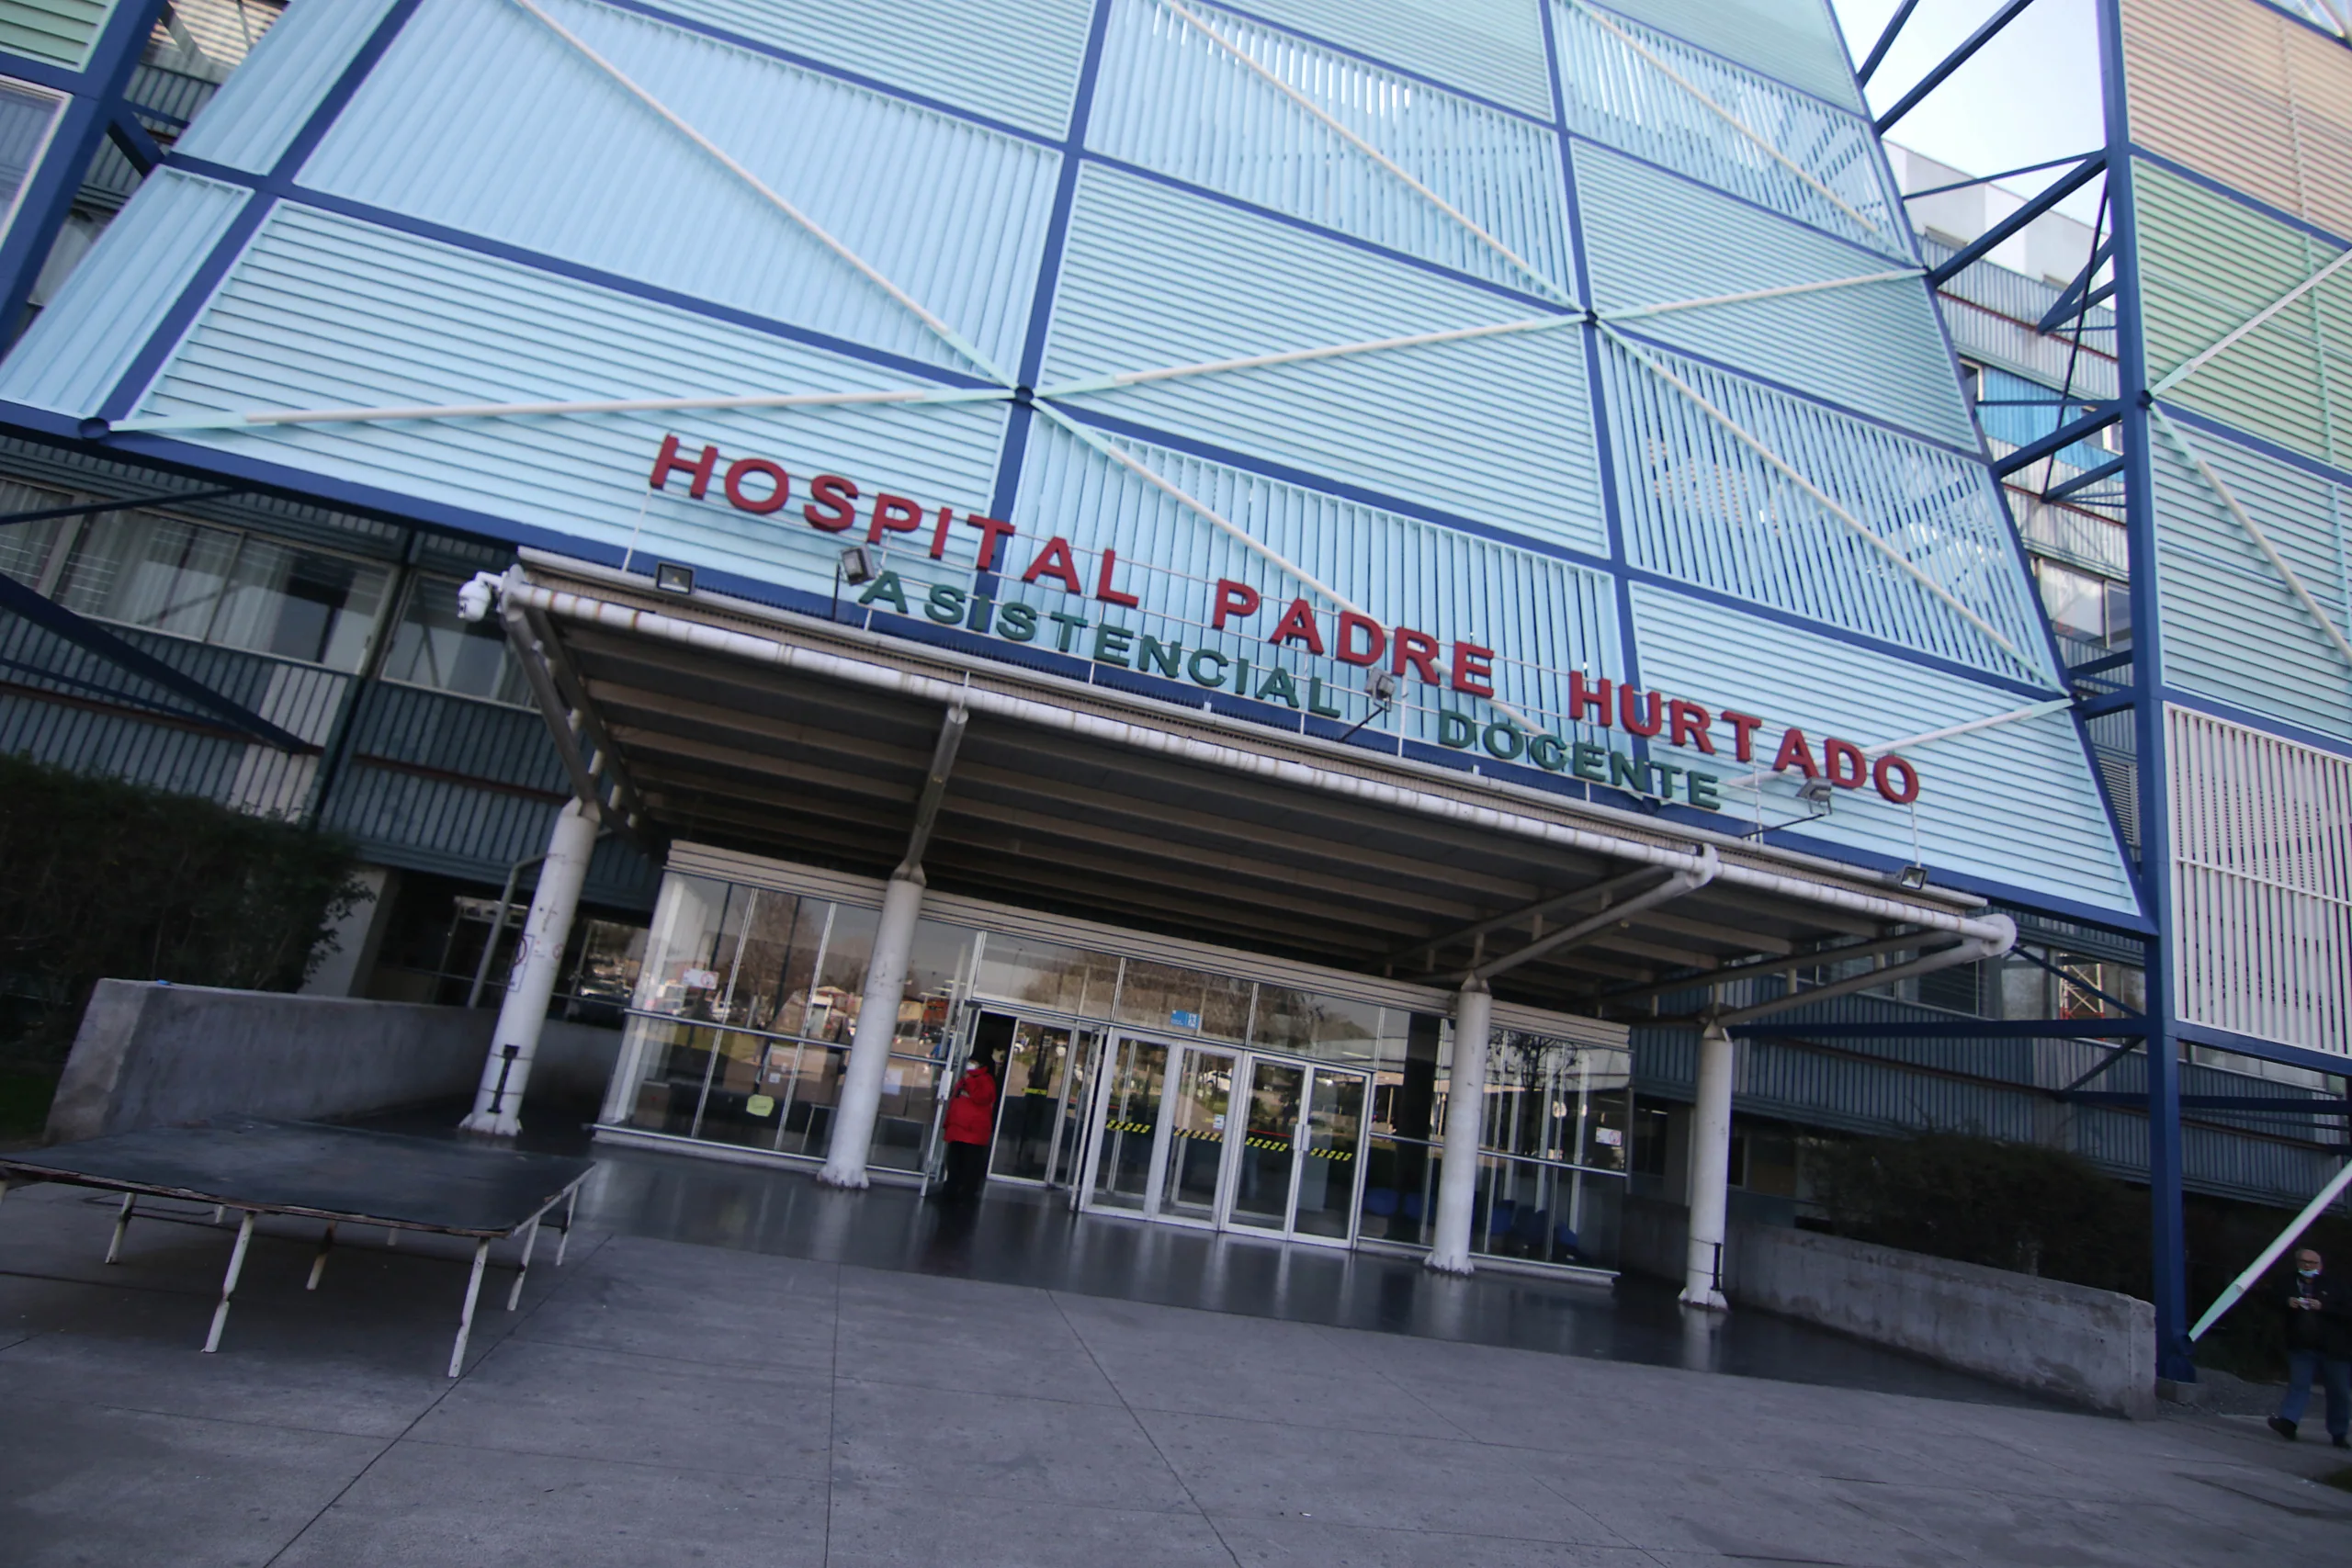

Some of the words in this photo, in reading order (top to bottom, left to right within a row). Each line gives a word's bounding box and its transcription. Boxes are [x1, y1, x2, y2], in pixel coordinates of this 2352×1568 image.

[649, 434, 1139, 608] HOSPITAL
[1212, 577, 1495, 699] PADRE
[1568, 671, 1919, 805] HURTADO
[857, 570, 1341, 718] ASISTENCIAL
[1439, 708, 1722, 812] DOCENTE
